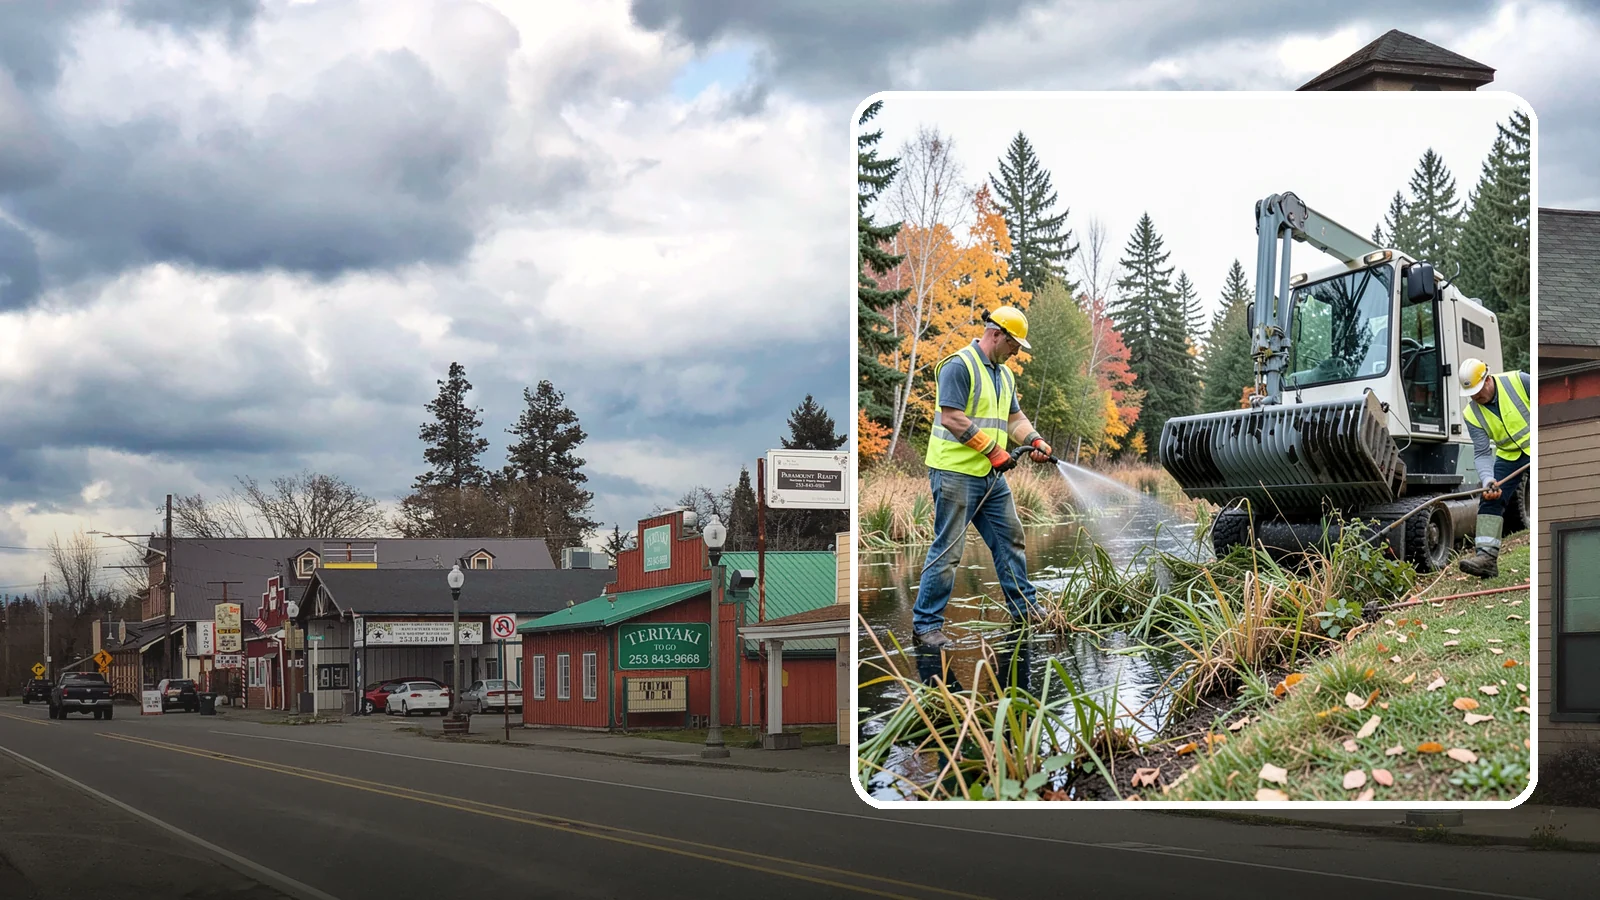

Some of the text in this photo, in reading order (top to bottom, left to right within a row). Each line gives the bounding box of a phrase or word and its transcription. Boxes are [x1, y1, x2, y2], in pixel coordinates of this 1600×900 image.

[625, 627, 702, 646] TERIYAKI
[628, 653, 700, 664] 253 843-9668
